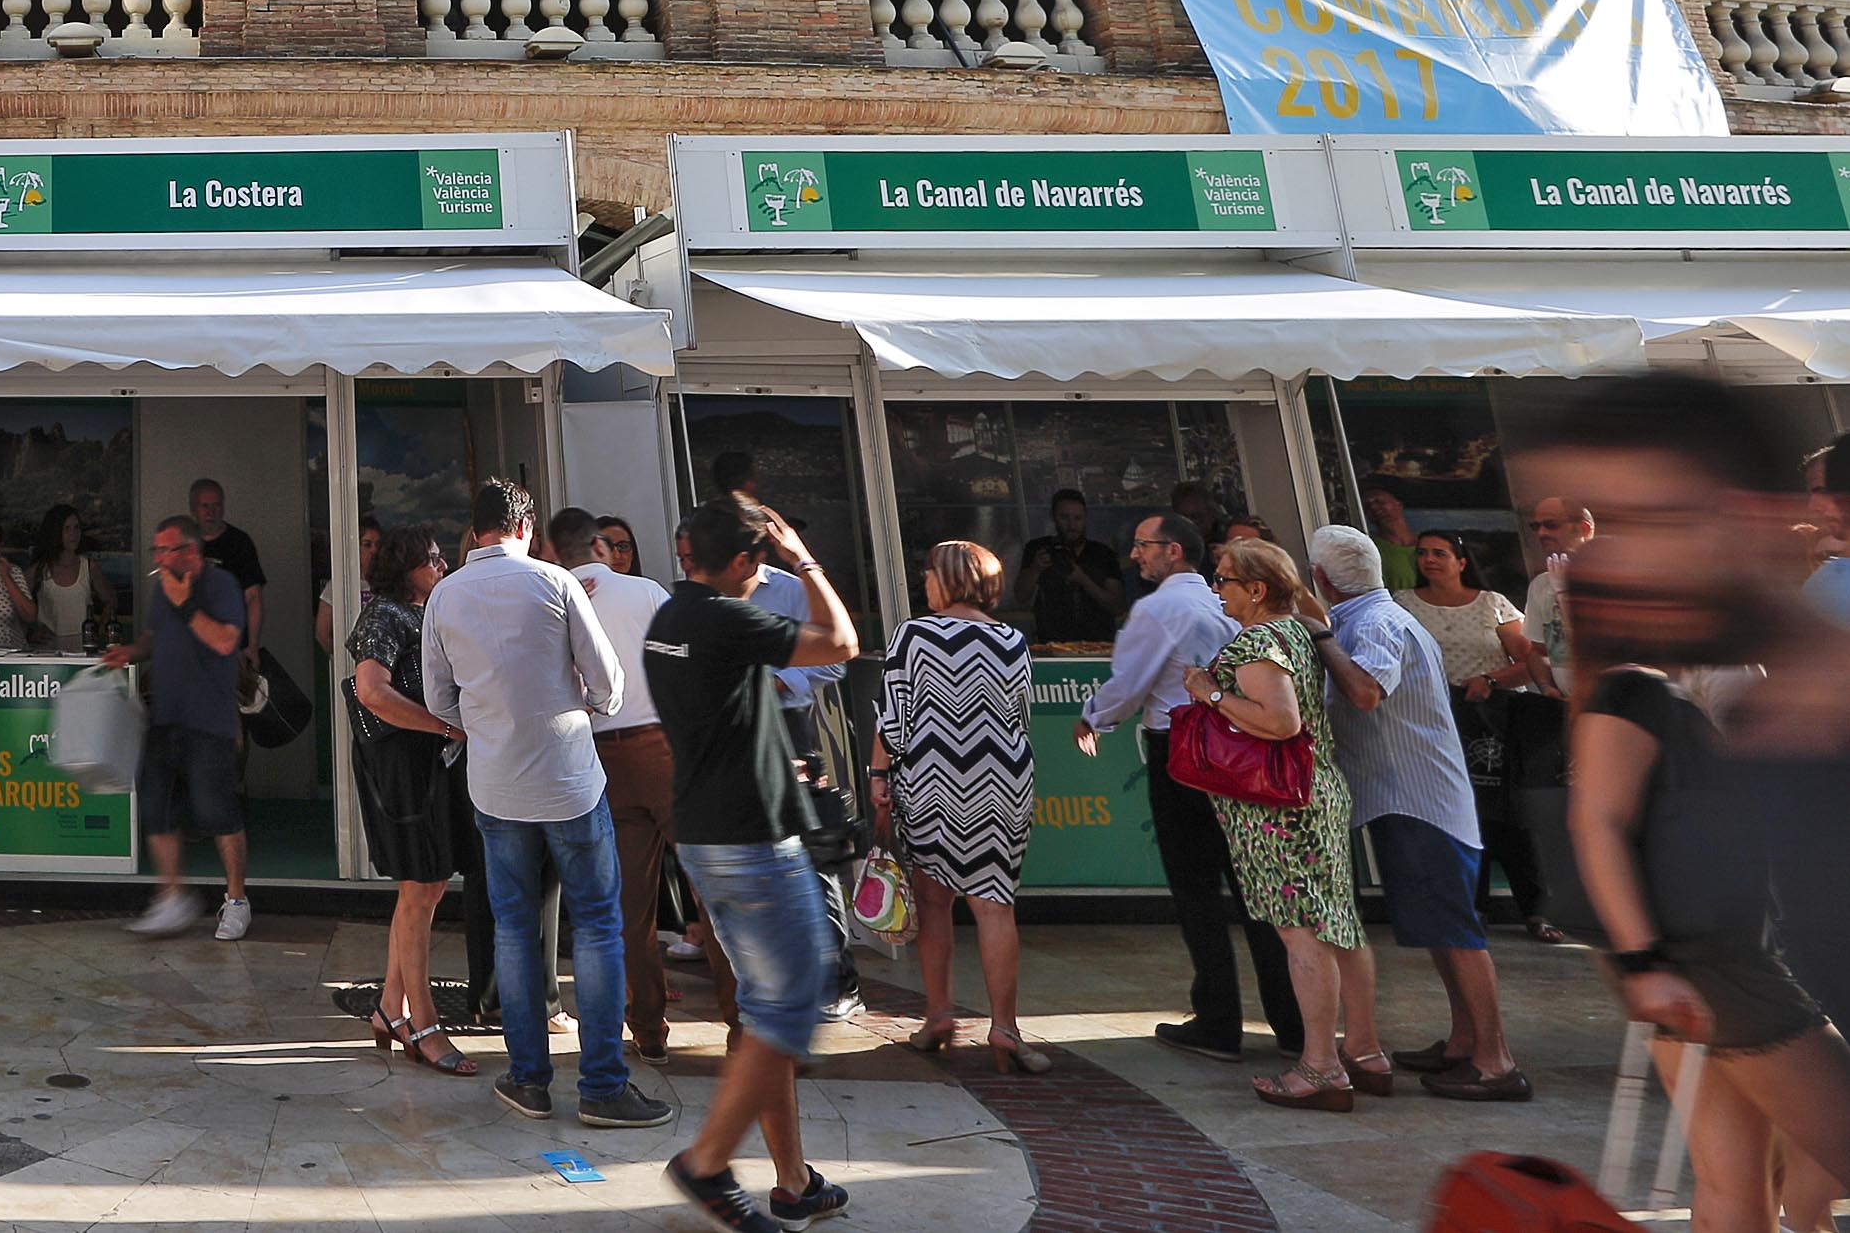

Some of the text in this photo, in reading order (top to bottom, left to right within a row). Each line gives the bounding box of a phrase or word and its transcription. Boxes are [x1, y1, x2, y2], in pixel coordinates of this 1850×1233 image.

[1261, 45, 1440, 120] 2017
[434, 173, 492, 185] València
[1204, 174, 1261, 187] València
[168, 179, 303, 208] La Costera
[432, 186, 489, 199] València
[879, 178, 1144, 208] La Canal de Navarrés
[1203, 188, 1260, 201] València
[1530, 176, 1792, 206] La Canal de Navarrés
[438, 201, 493, 213] Turisme
[1211, 202, 1265, 215] Turisme
